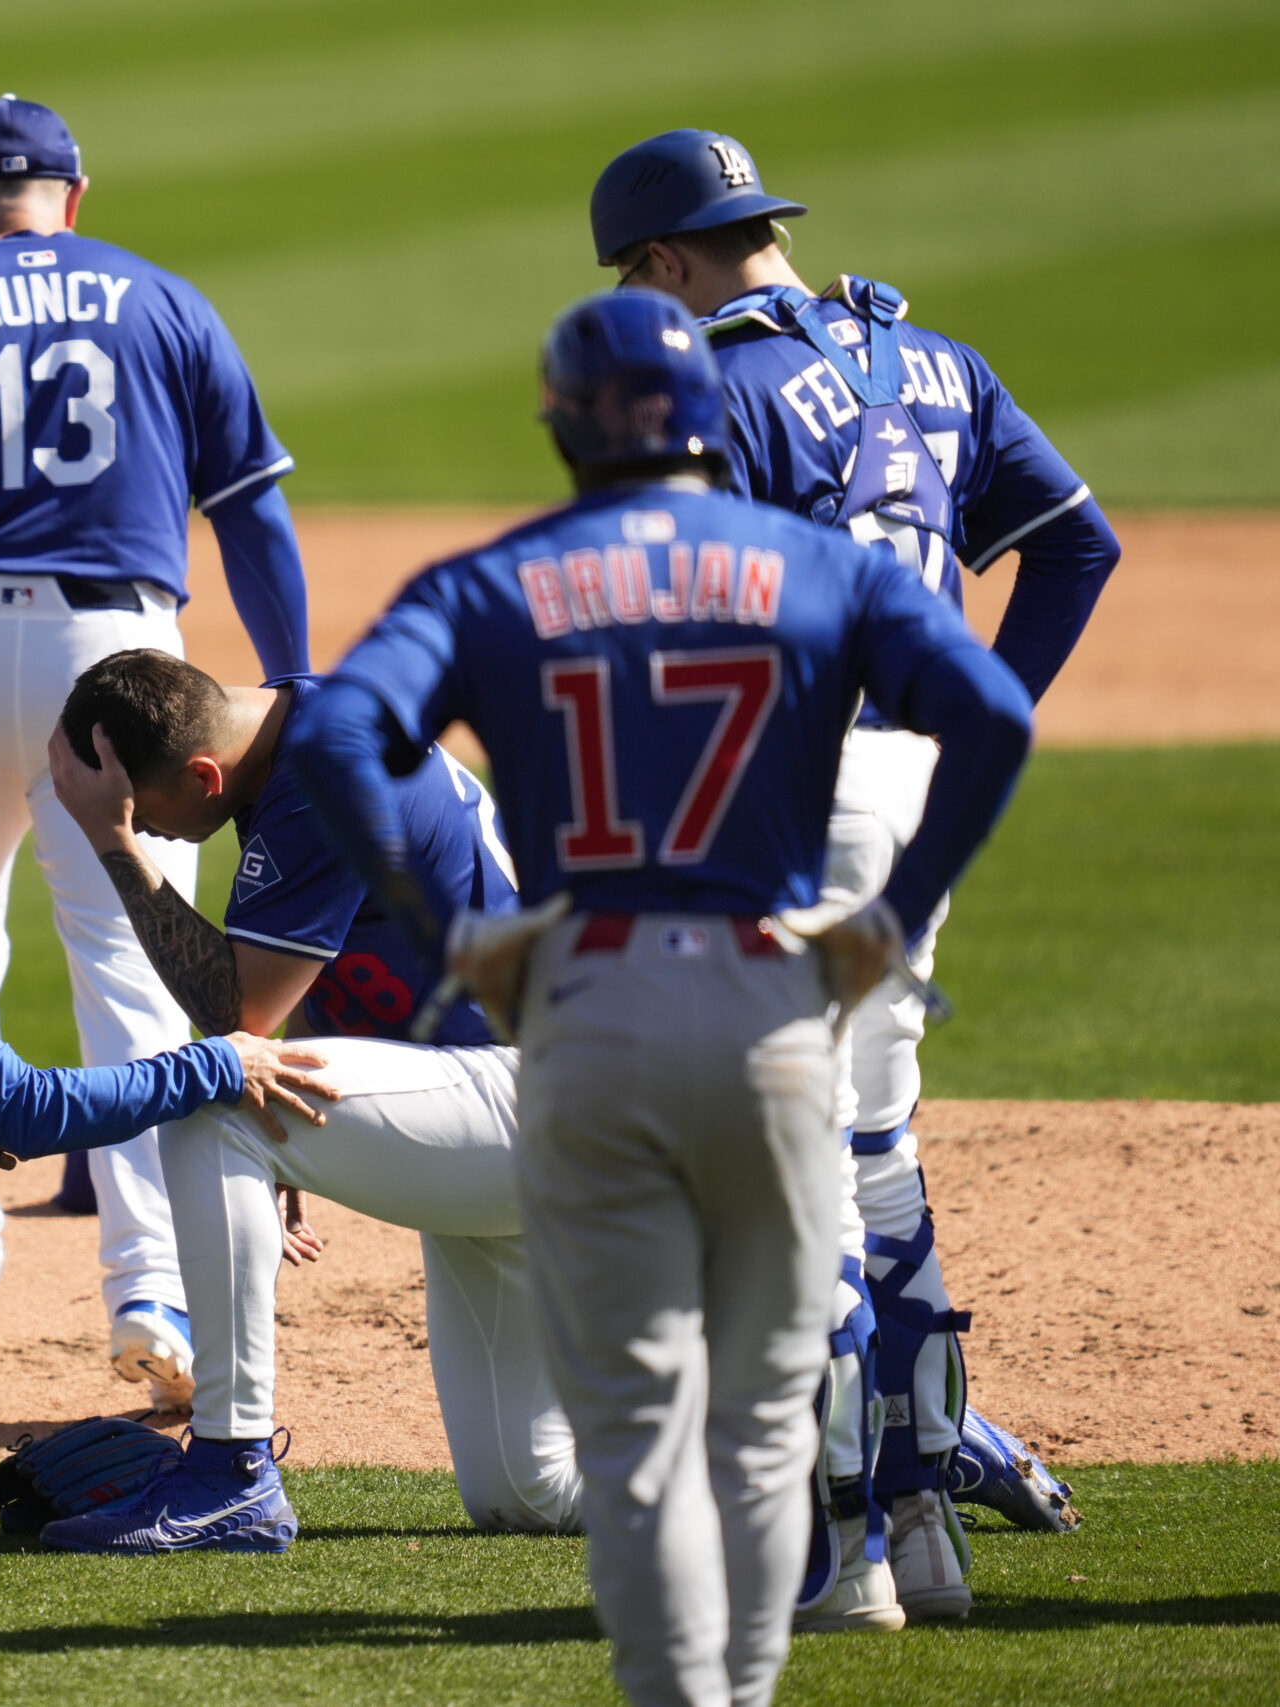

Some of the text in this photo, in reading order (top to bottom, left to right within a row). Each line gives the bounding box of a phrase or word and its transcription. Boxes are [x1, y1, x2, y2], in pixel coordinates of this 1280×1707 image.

[518, 540, 785, 640] BRUJAN
[541, 645, 782, 872] 17
[242, 851, 265, 878] G
[307, 952, 412, 1036] 28
